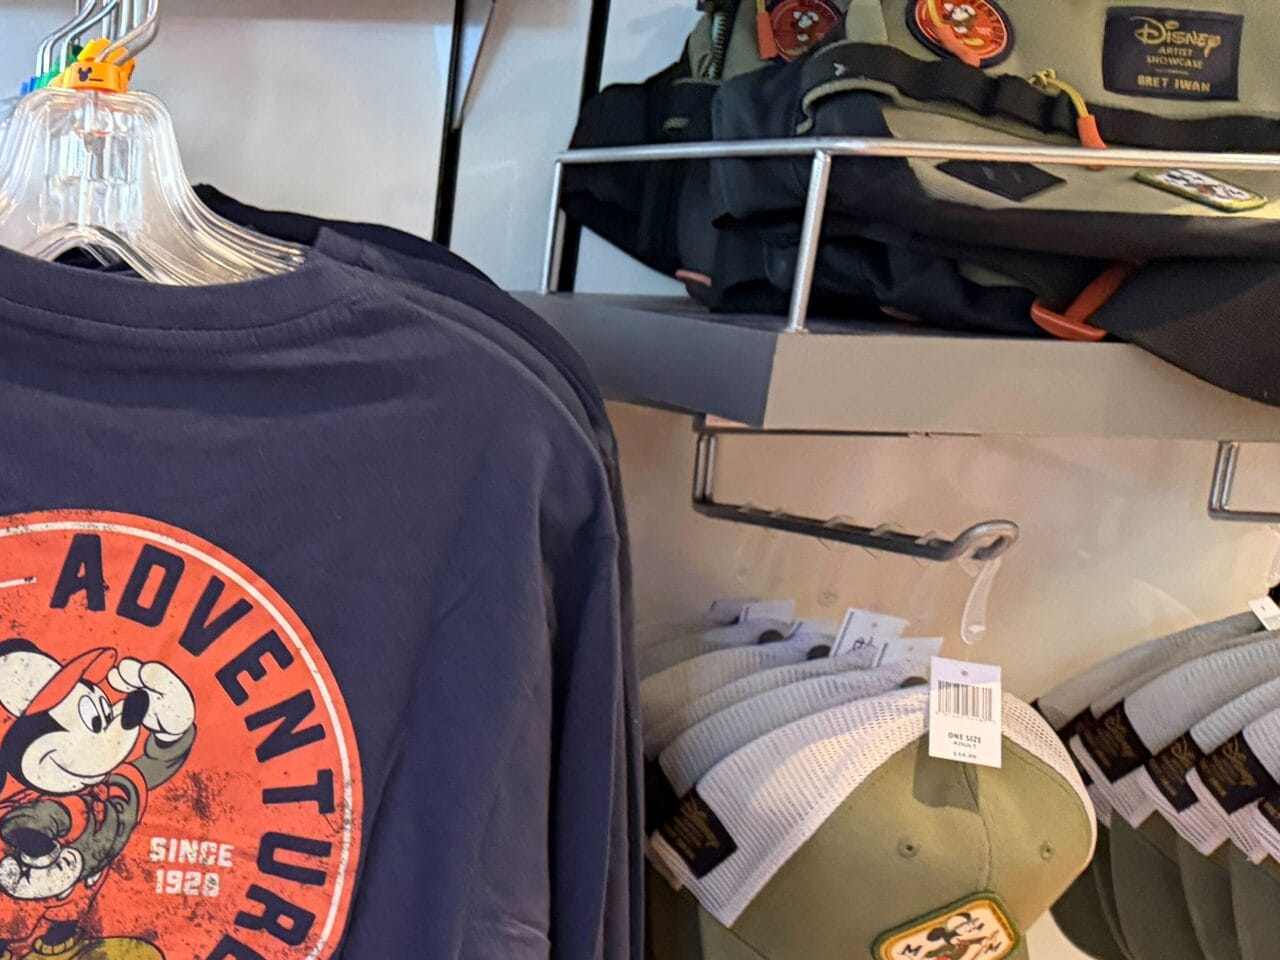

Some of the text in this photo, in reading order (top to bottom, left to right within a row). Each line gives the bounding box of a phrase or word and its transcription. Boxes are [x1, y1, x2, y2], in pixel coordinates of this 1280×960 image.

[1158, 47, 1193, 56] ARTIST
[1145, 55, 1204, 69] SHOWCASE
[1137, 75, 1211, 92] BRET IWAN
[948, 732, 982, 744] ONE SIZE
[149, 837, 234, 867] SINCE
[155, 869, 220, 897] 1928
